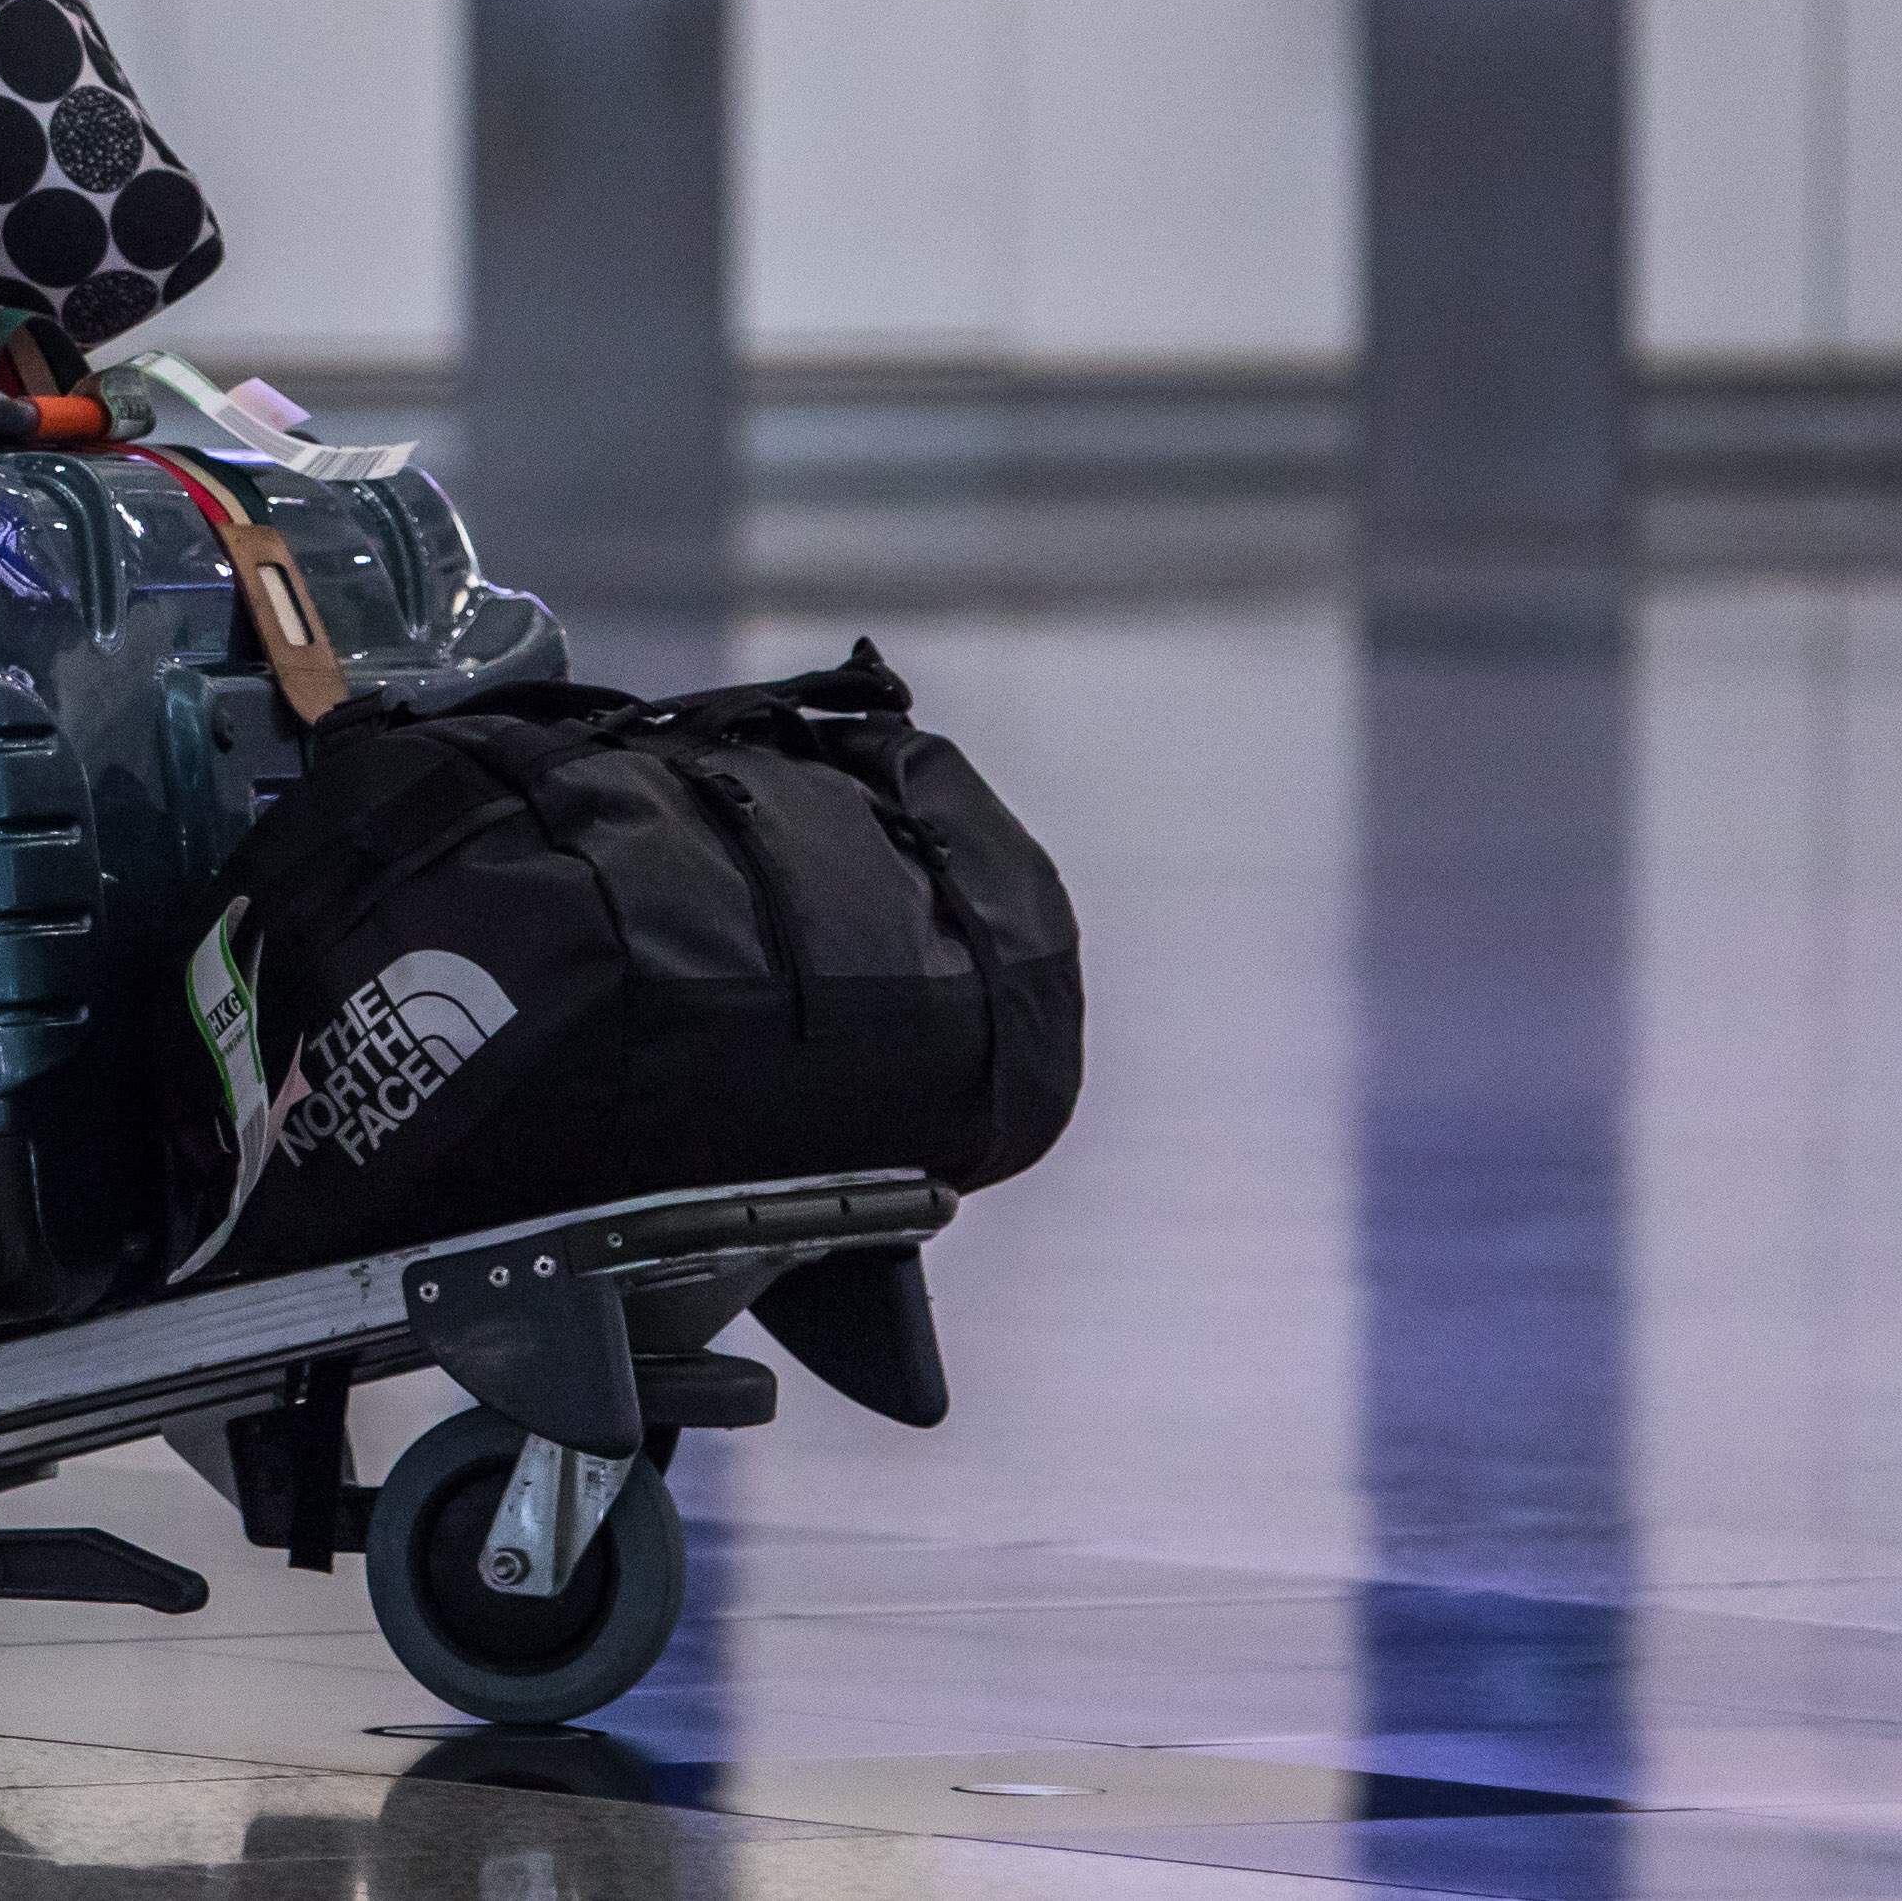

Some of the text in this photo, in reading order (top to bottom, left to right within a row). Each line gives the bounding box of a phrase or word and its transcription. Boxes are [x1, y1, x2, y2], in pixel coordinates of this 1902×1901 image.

[207, 992, 243, 1036] HKG
[308, 980, 392, 1069] THE
[278, 1014, 416, 1167] NORTH
[334, 1049, 447, 1167] FACE
